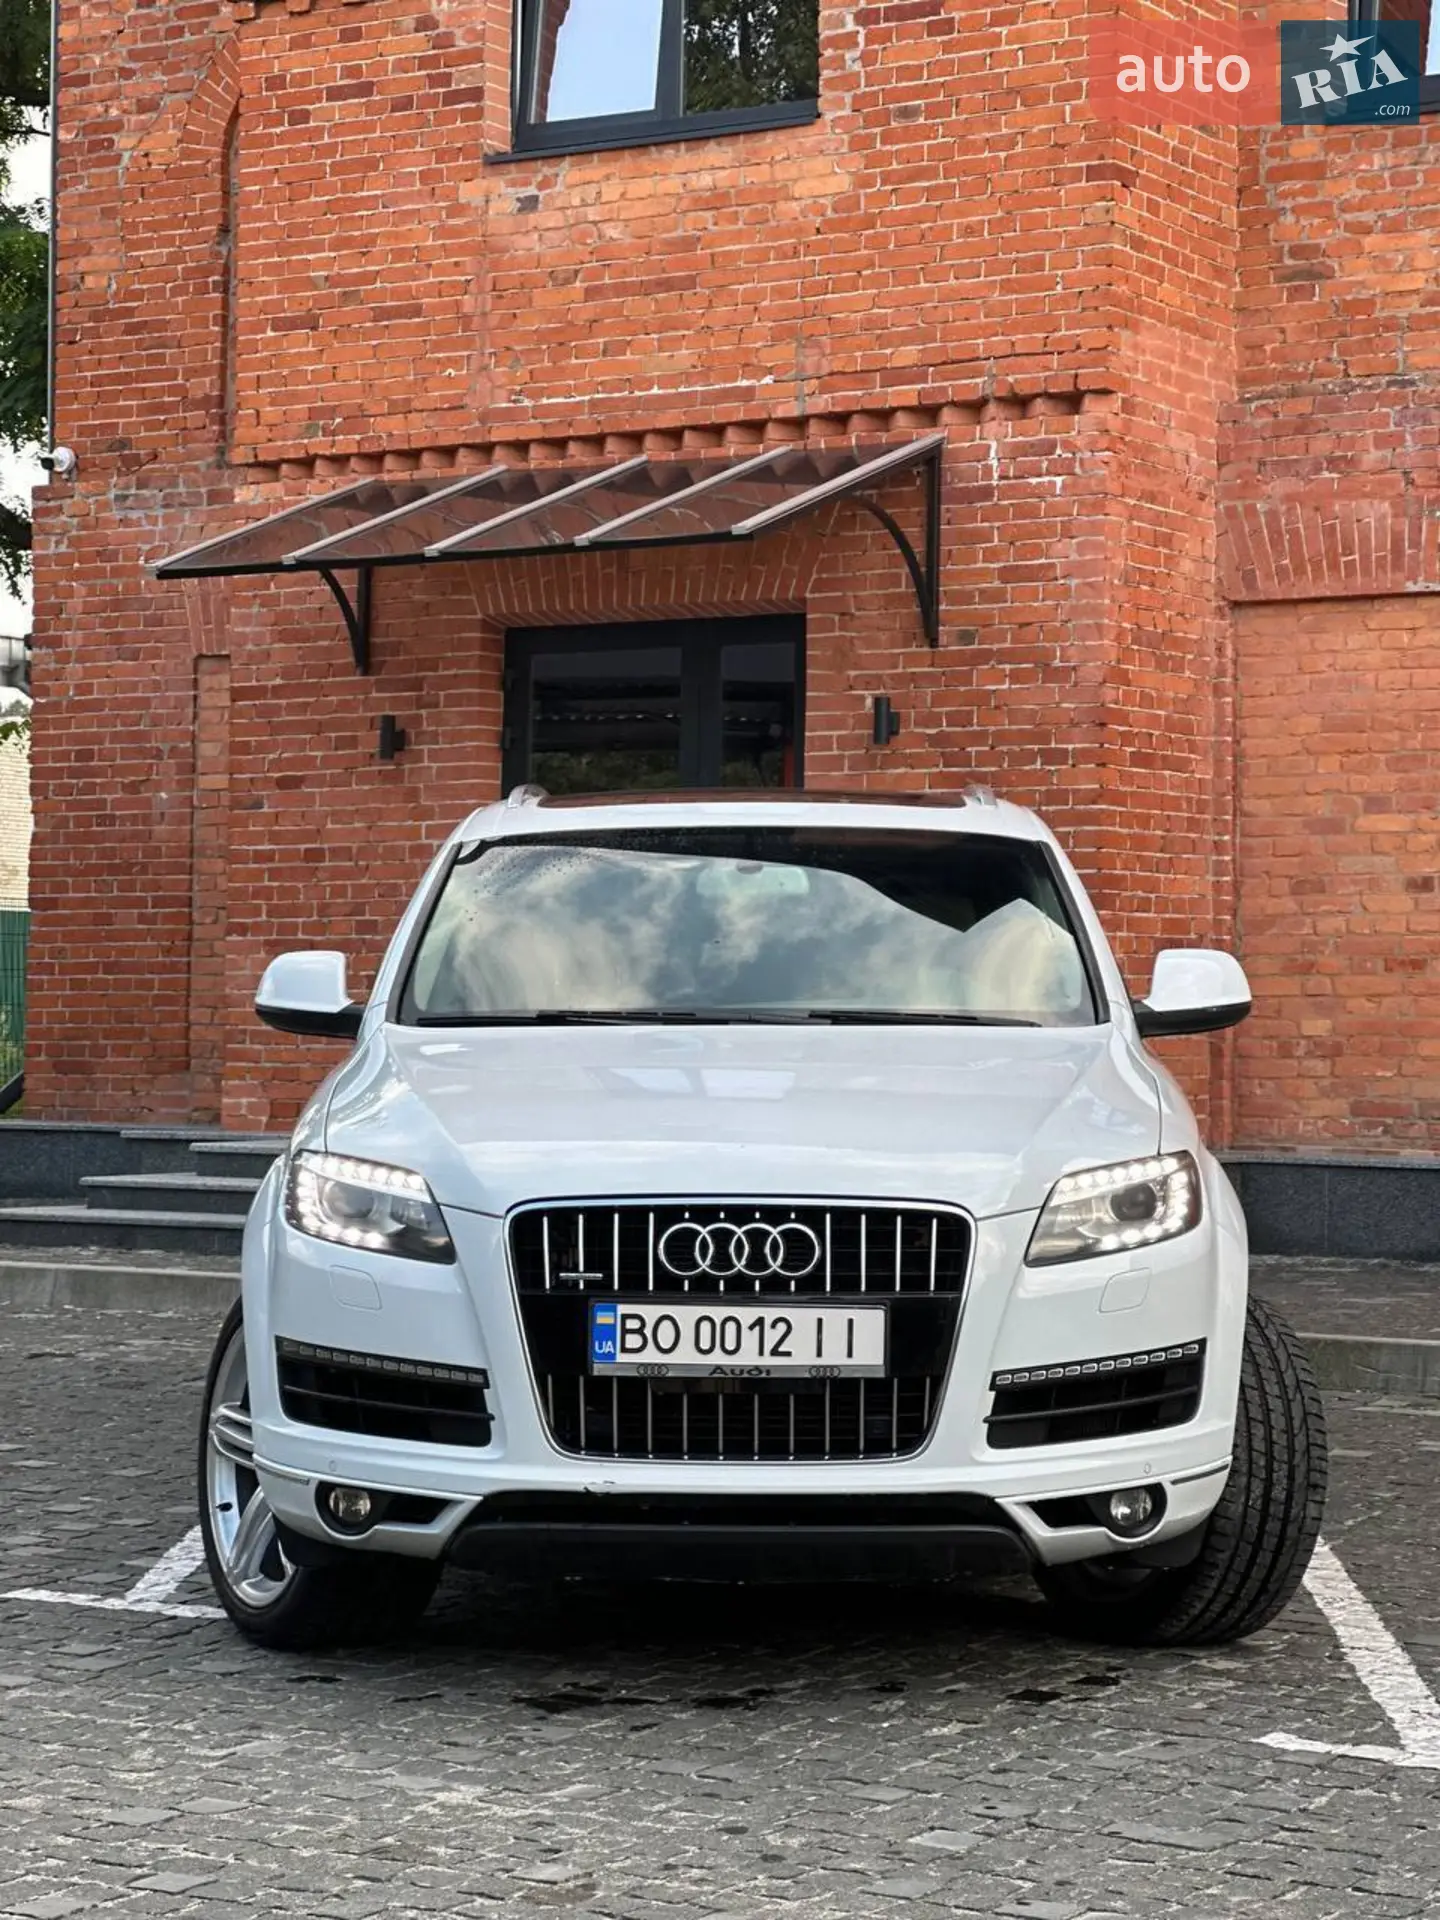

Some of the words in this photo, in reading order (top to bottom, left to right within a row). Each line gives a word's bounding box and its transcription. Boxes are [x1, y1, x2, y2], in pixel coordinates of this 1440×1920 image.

[620, 1313, 681, 1355] BO
[694, 1315, 793, 1357] 0012
[595, 1340, 614, 1354] UA
[708, 1366, 771, 1376] Audi
